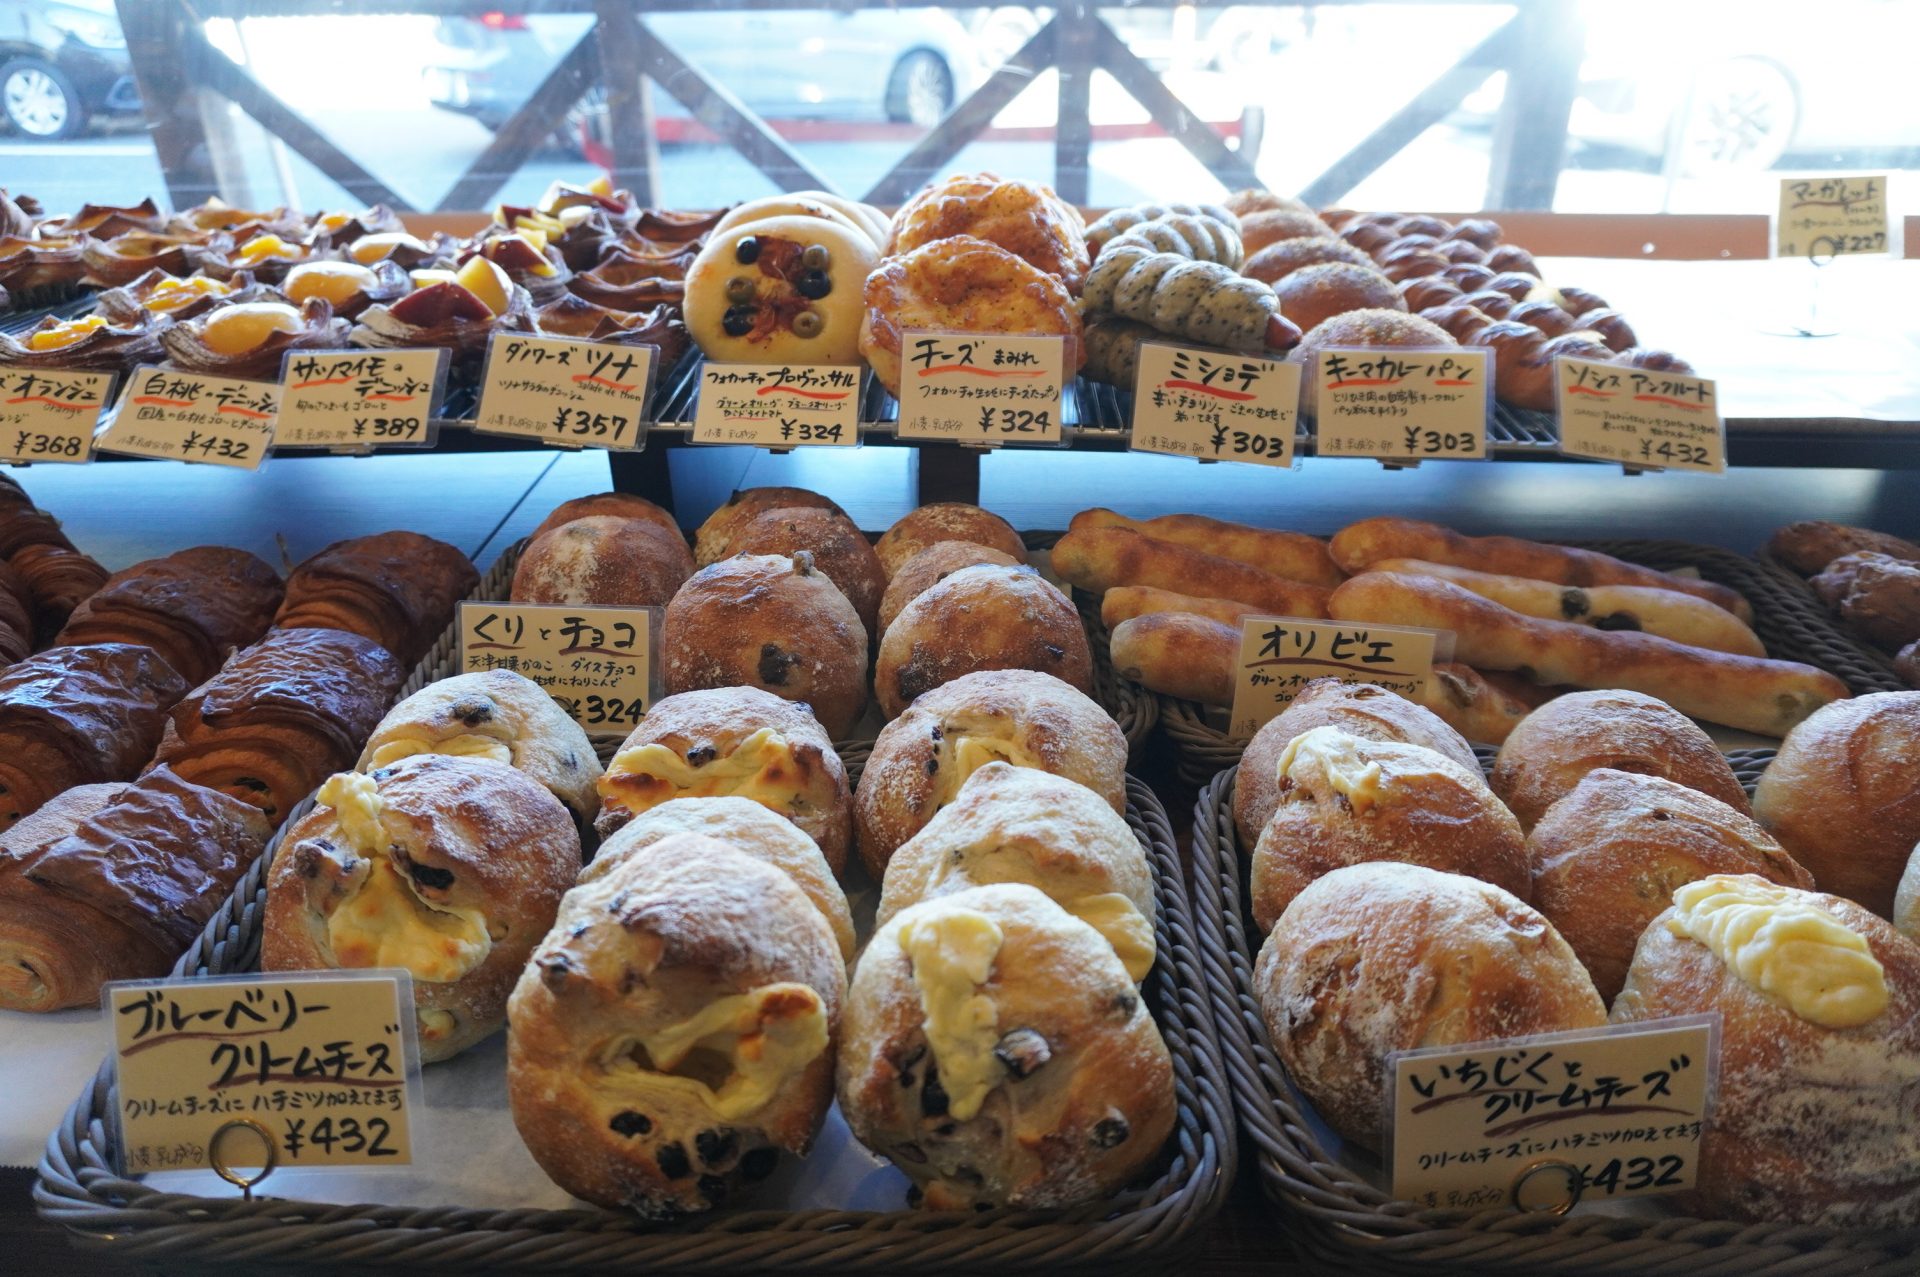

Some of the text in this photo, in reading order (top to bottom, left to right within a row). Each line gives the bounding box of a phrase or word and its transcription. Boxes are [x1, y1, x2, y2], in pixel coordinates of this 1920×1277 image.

[586, 348, 639, 382] ツナ
[911, 338, 1040, 369] チーズ まみれ
[13, 373, 98, 400] オランジェ
[354, 377, 430, 397] デニッシュ
[765, 366, 859, 389] プロヴァンサル
[1170, 352, 1276, 392] ミショデ
[1630, 373, 1713, 402] アンクルート
[352, 417, 420, 440] ¥389
[551, 406, 628, 441] ¥357
[780, 418, 844, 443] ¥324
[978, 406, 1052, 434] ¥324
[13, 430, 82, 457] ¥368
[181, 430, 250, 460] ¥432
[1210, 422, 1285, 459] ¥303
[1404, 425, 1476, 454] ¥303
[1639, 437, 1713, 466] ¥432
[1259, 624, 1395, 663] オリビエ
[118, 989, 331, 1040] ブルーベリー
[209, 1023, 401, 1087] クリームチーズ
[1408, 1051, 1582, 1098] いちじくと
[1484, 1053, 1691, 1124] クリームチーズ
[283, 1116, 400, 1159] ¥432
[1566, 1154, 1685, 1195] ¥432
